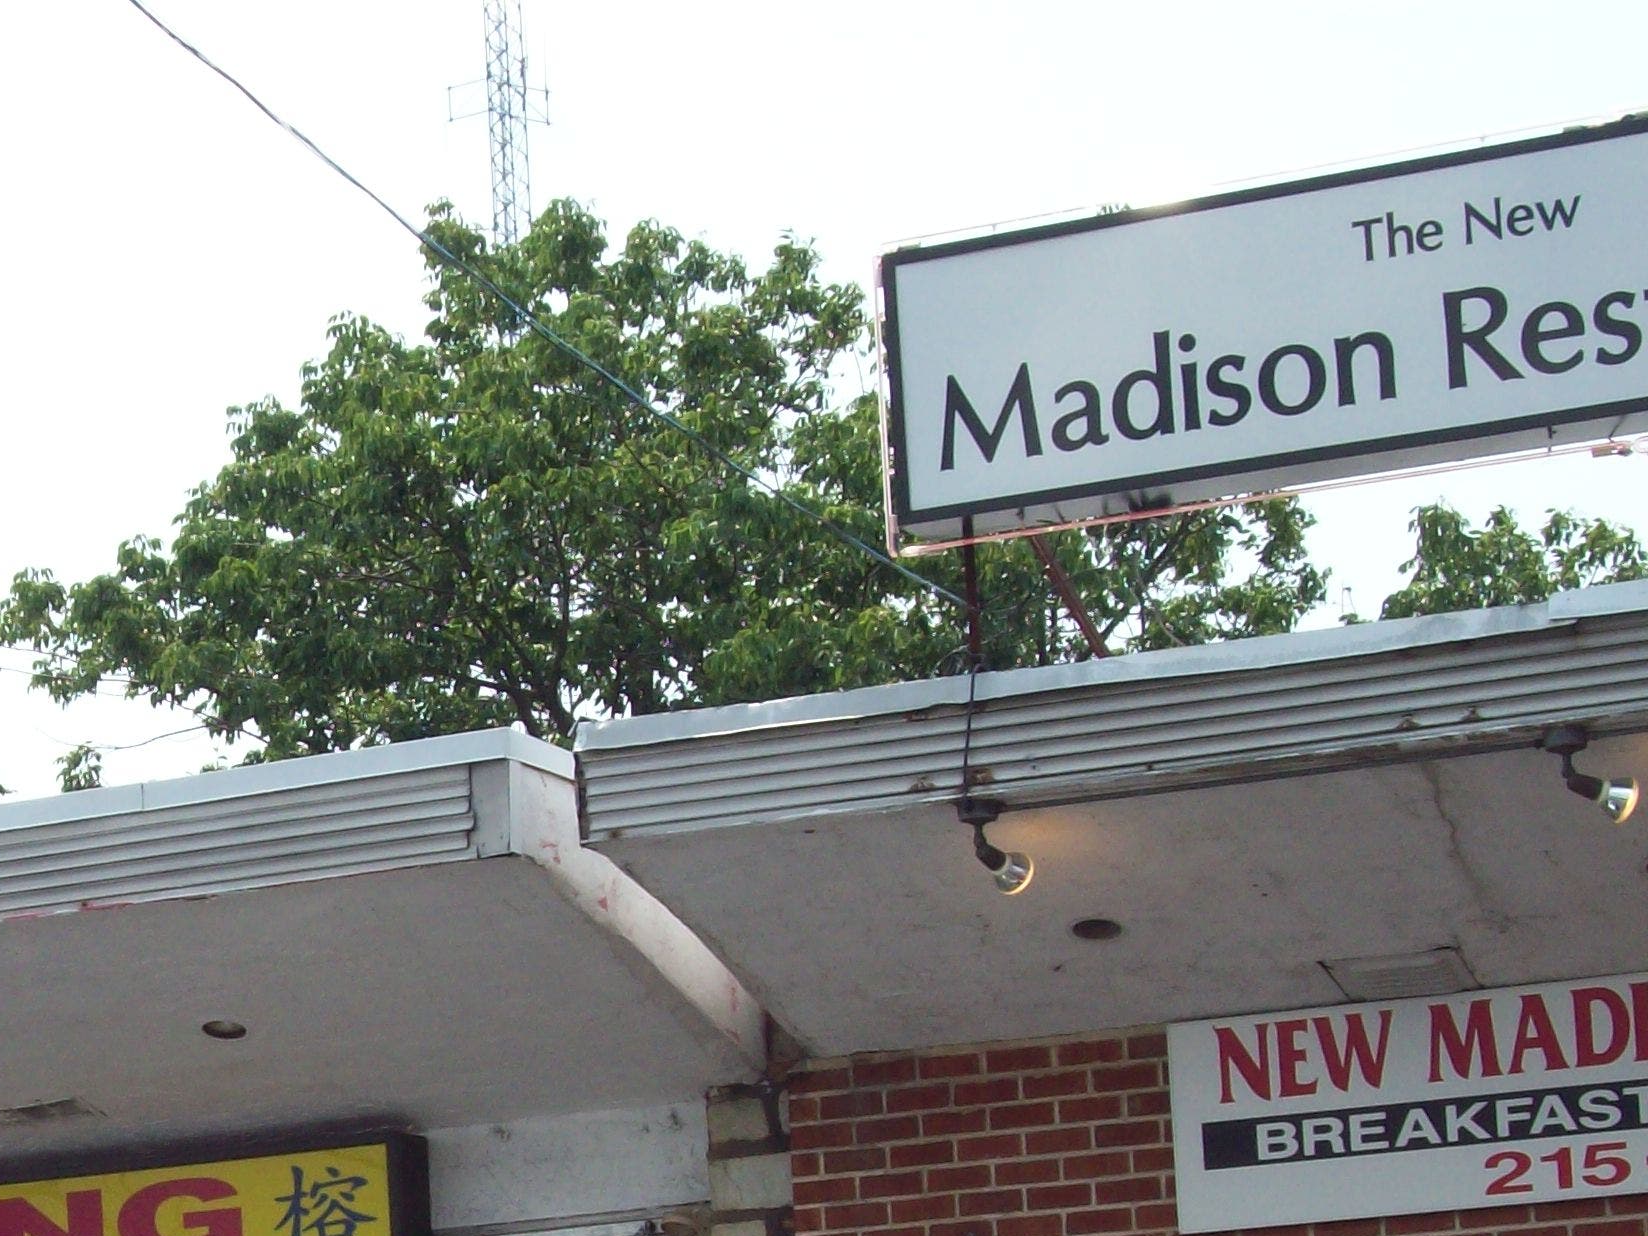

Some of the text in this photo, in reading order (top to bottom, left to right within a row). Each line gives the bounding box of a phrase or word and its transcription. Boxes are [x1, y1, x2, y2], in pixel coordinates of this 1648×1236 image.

[1352, 195, 1581, 262] The New
[940, 284, 1648, 470] Madison Res
[1213, 1010, 1393, 1104] NEW
[1256, 1086, 1648, 1160] BREAKFAST
[1484, 1142, 1632, 1195] 215
